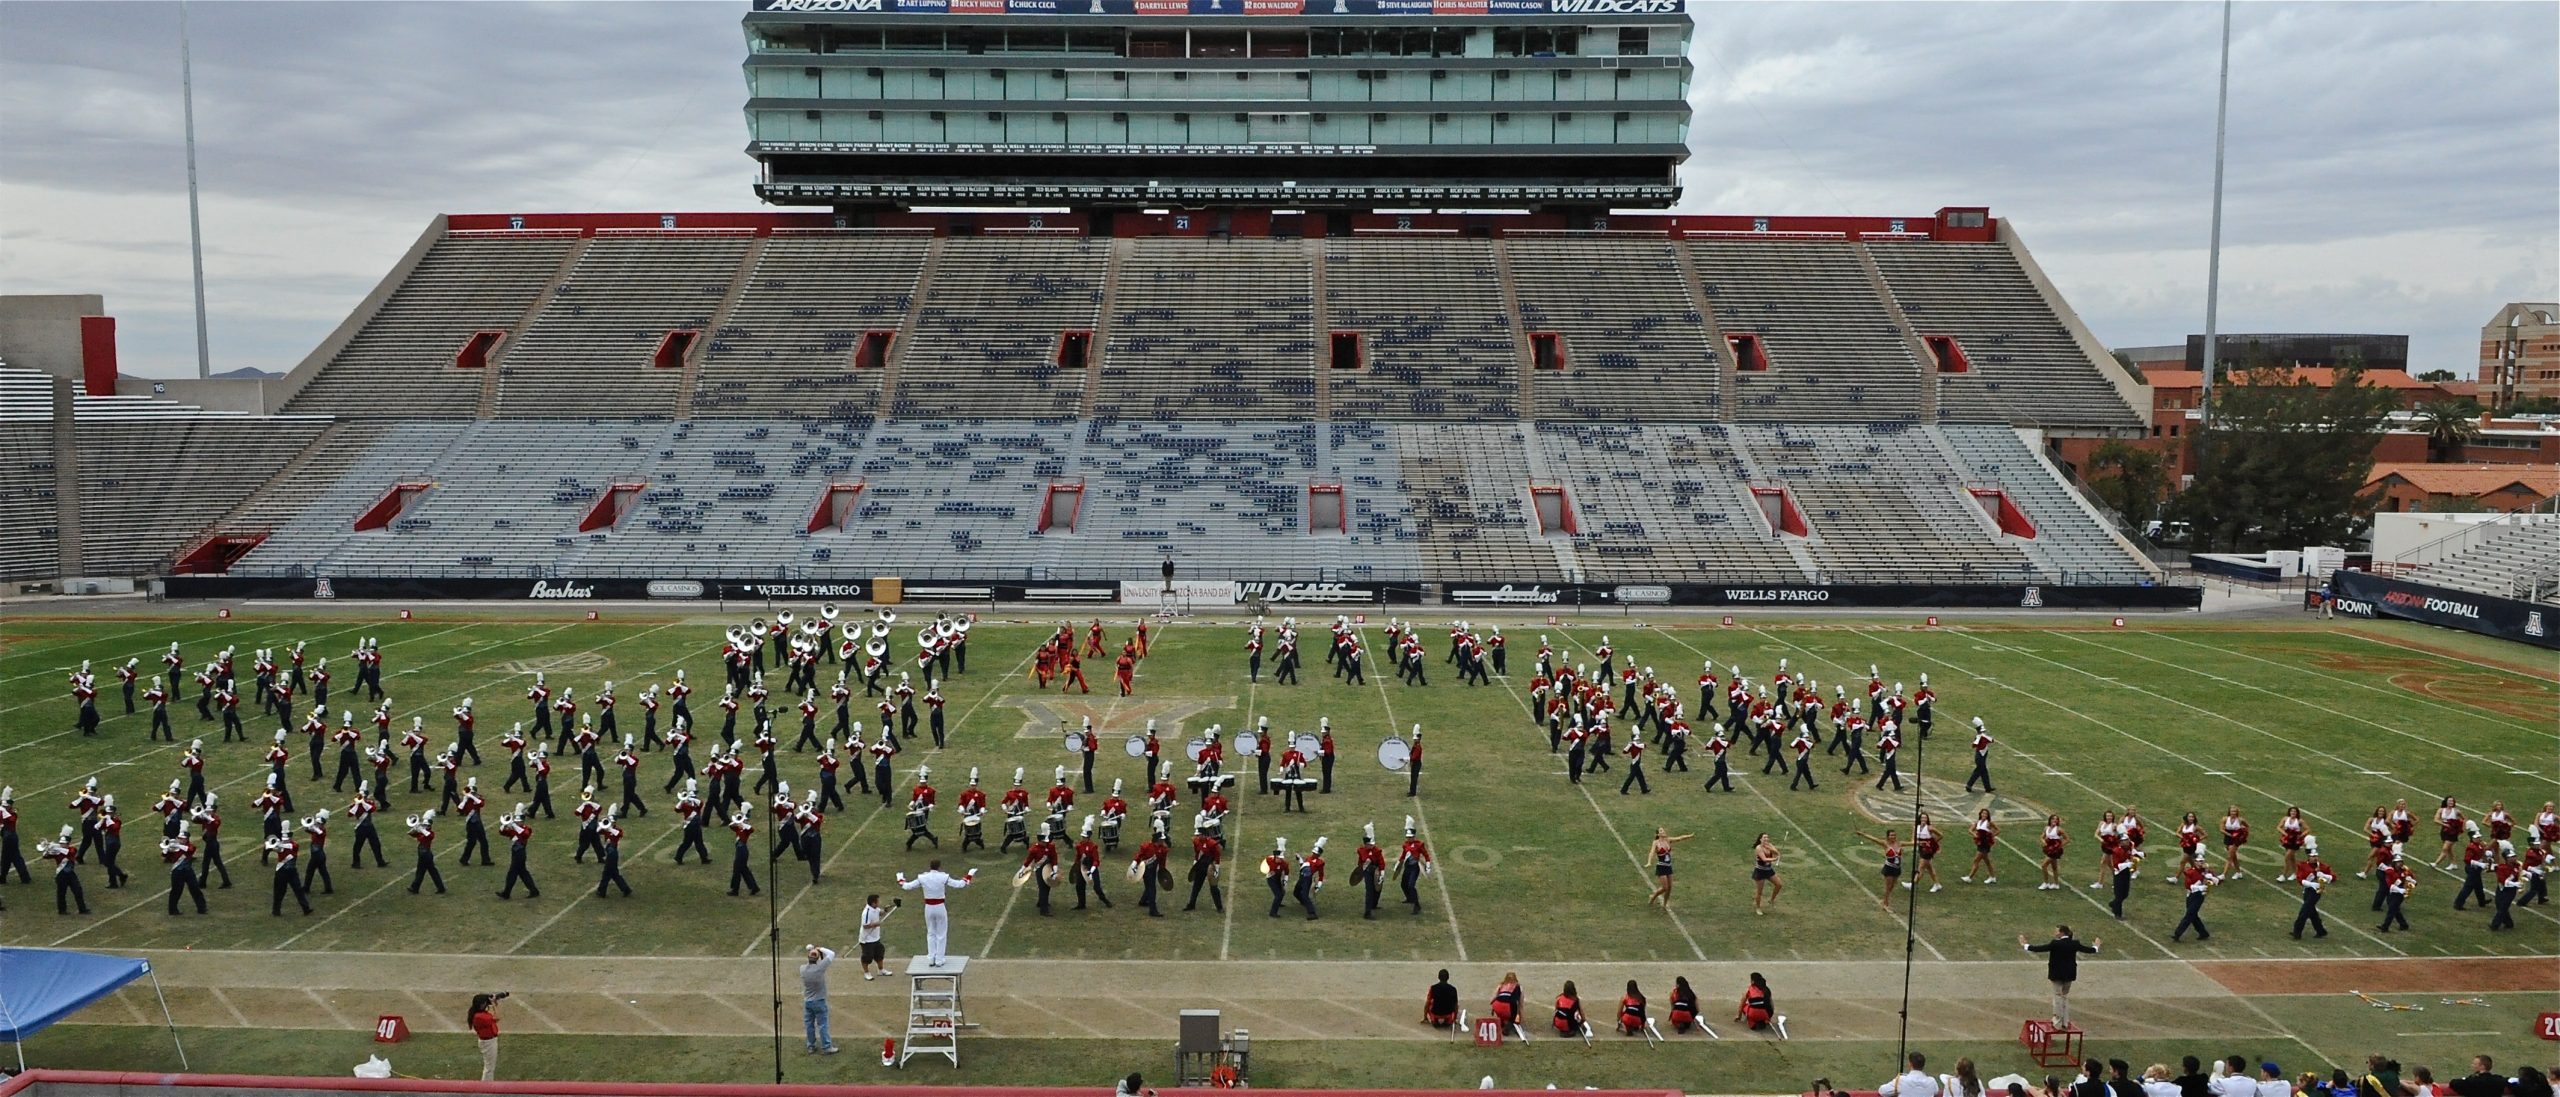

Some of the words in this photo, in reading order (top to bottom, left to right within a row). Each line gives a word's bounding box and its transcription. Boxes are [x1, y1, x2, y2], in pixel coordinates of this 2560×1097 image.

[766, 0, 882, 11] ARIZONA
[1433, 0, 1439, 8] 11
[1551, 0, 1678, 12] WILDCATS
[512, 221, 522, 229] 17
[663, 220, 674, 228] 18
[835, 219, 846, 228] 19
[1029, 220, 1042, 229] 20
[1177, 220, 1188, 229] 21
[1398, 221, 1410, 229] 22
[1594, 221, 1607, 230] 23
[1754, 223, 1767, 232] 24
[1891, 224, 1904, 232] 25
[154, 384, 165, 392] 16
[529, 580, 594, 598] Bashas'
[757, 585, 807, 596] WELLS
[811, 585, 860, 596] FARGO
[1199, 588, 1217, 597] BAND
[1218, 588, 1232, 597] DAY
[1725, 590, 1776, 601] WELLS
[1780, 590, 1828, 601] FARGO
[2337, 598, 2372, 616] DOWN
[2424, 597, 2480, 619] FOOTBALL
[377, 1019, 396, 1039] 40
[1479, 1022, 1497, 1042] 40
